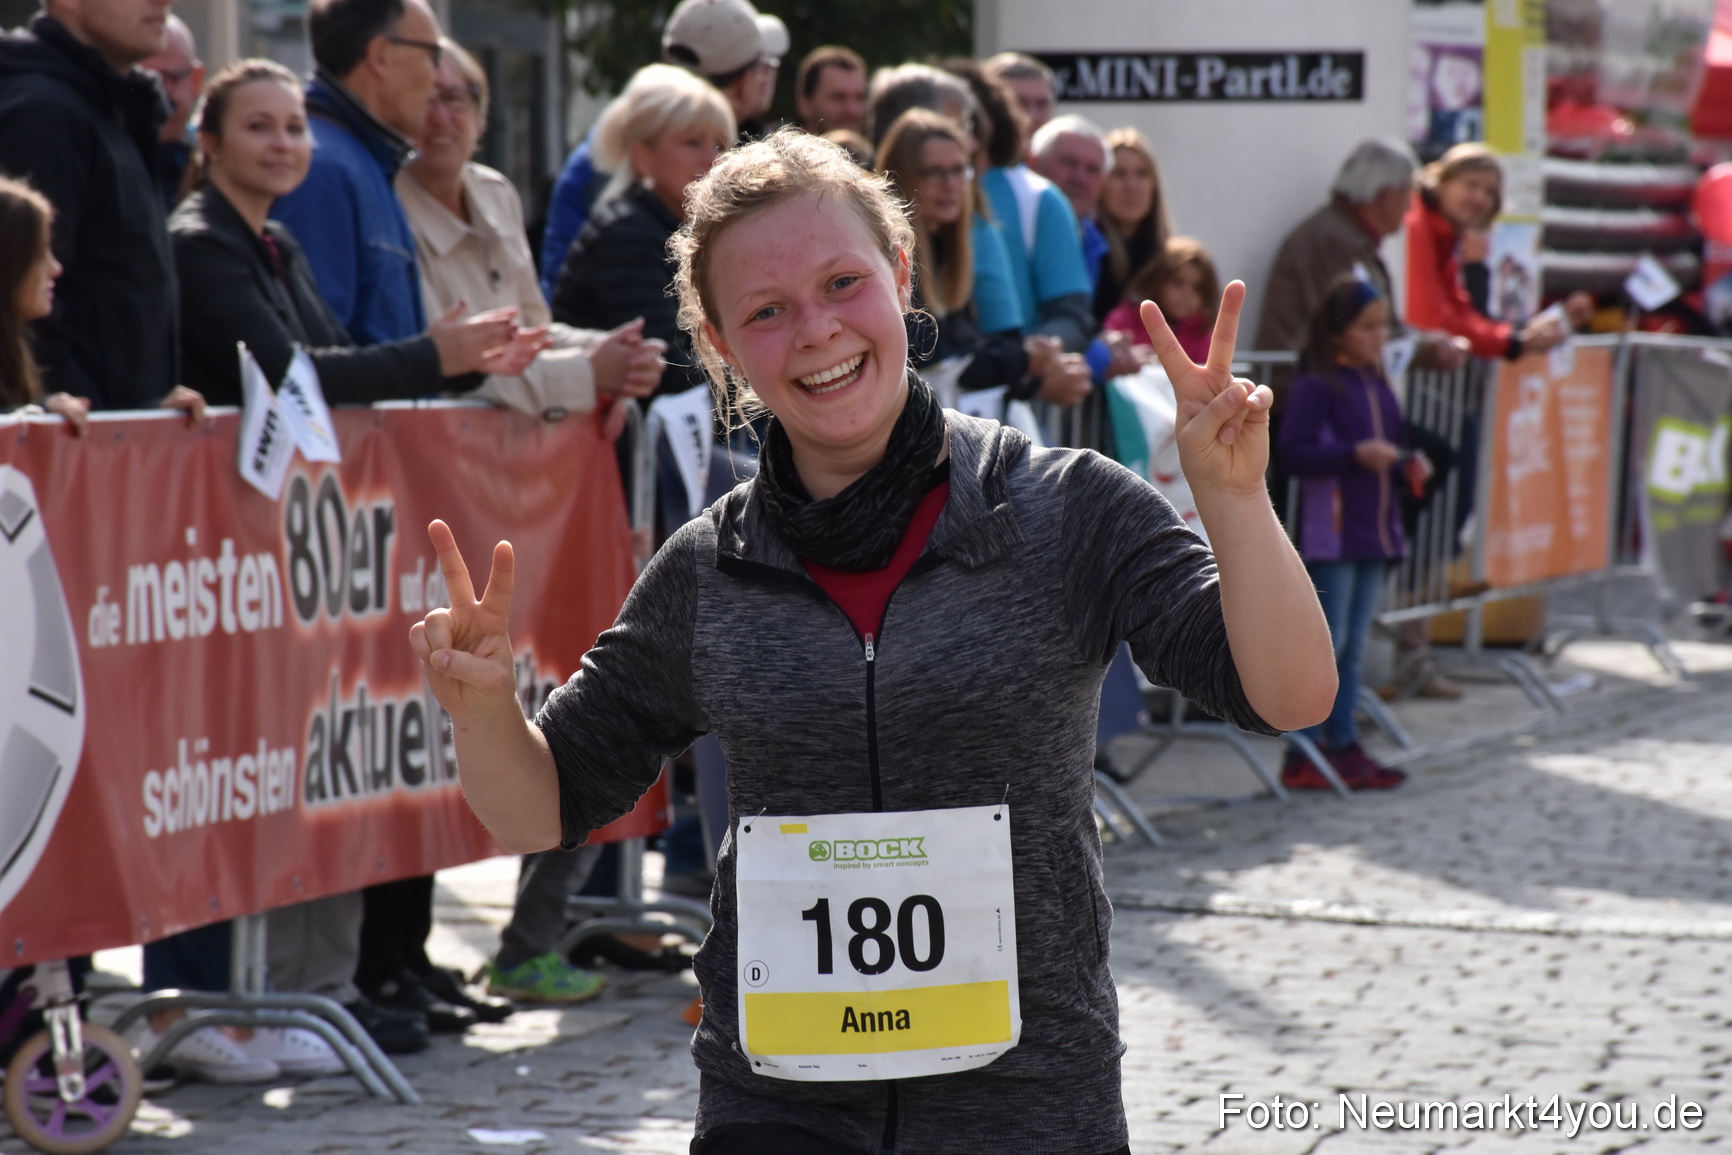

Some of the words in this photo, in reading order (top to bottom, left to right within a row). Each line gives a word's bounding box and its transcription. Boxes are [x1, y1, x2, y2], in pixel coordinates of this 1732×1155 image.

[88, 585, 120, 648] die
[125, 527, 283, 646] meisten
[285, 472, 394, 624] 80er
[143, 738, 297, 838] schönsten
[833, 837, 928, 862] BOCK
[833, 861, 861, 871] inspired
[862, 861, 872, 870] by
[873, 860, 895, 868] smart
[896, 859, 929, 868] concepts
[801, 893, 946, 976] 180
[751, 967, 761, 982] D
[840, 1005, 912, 1034] Anna
